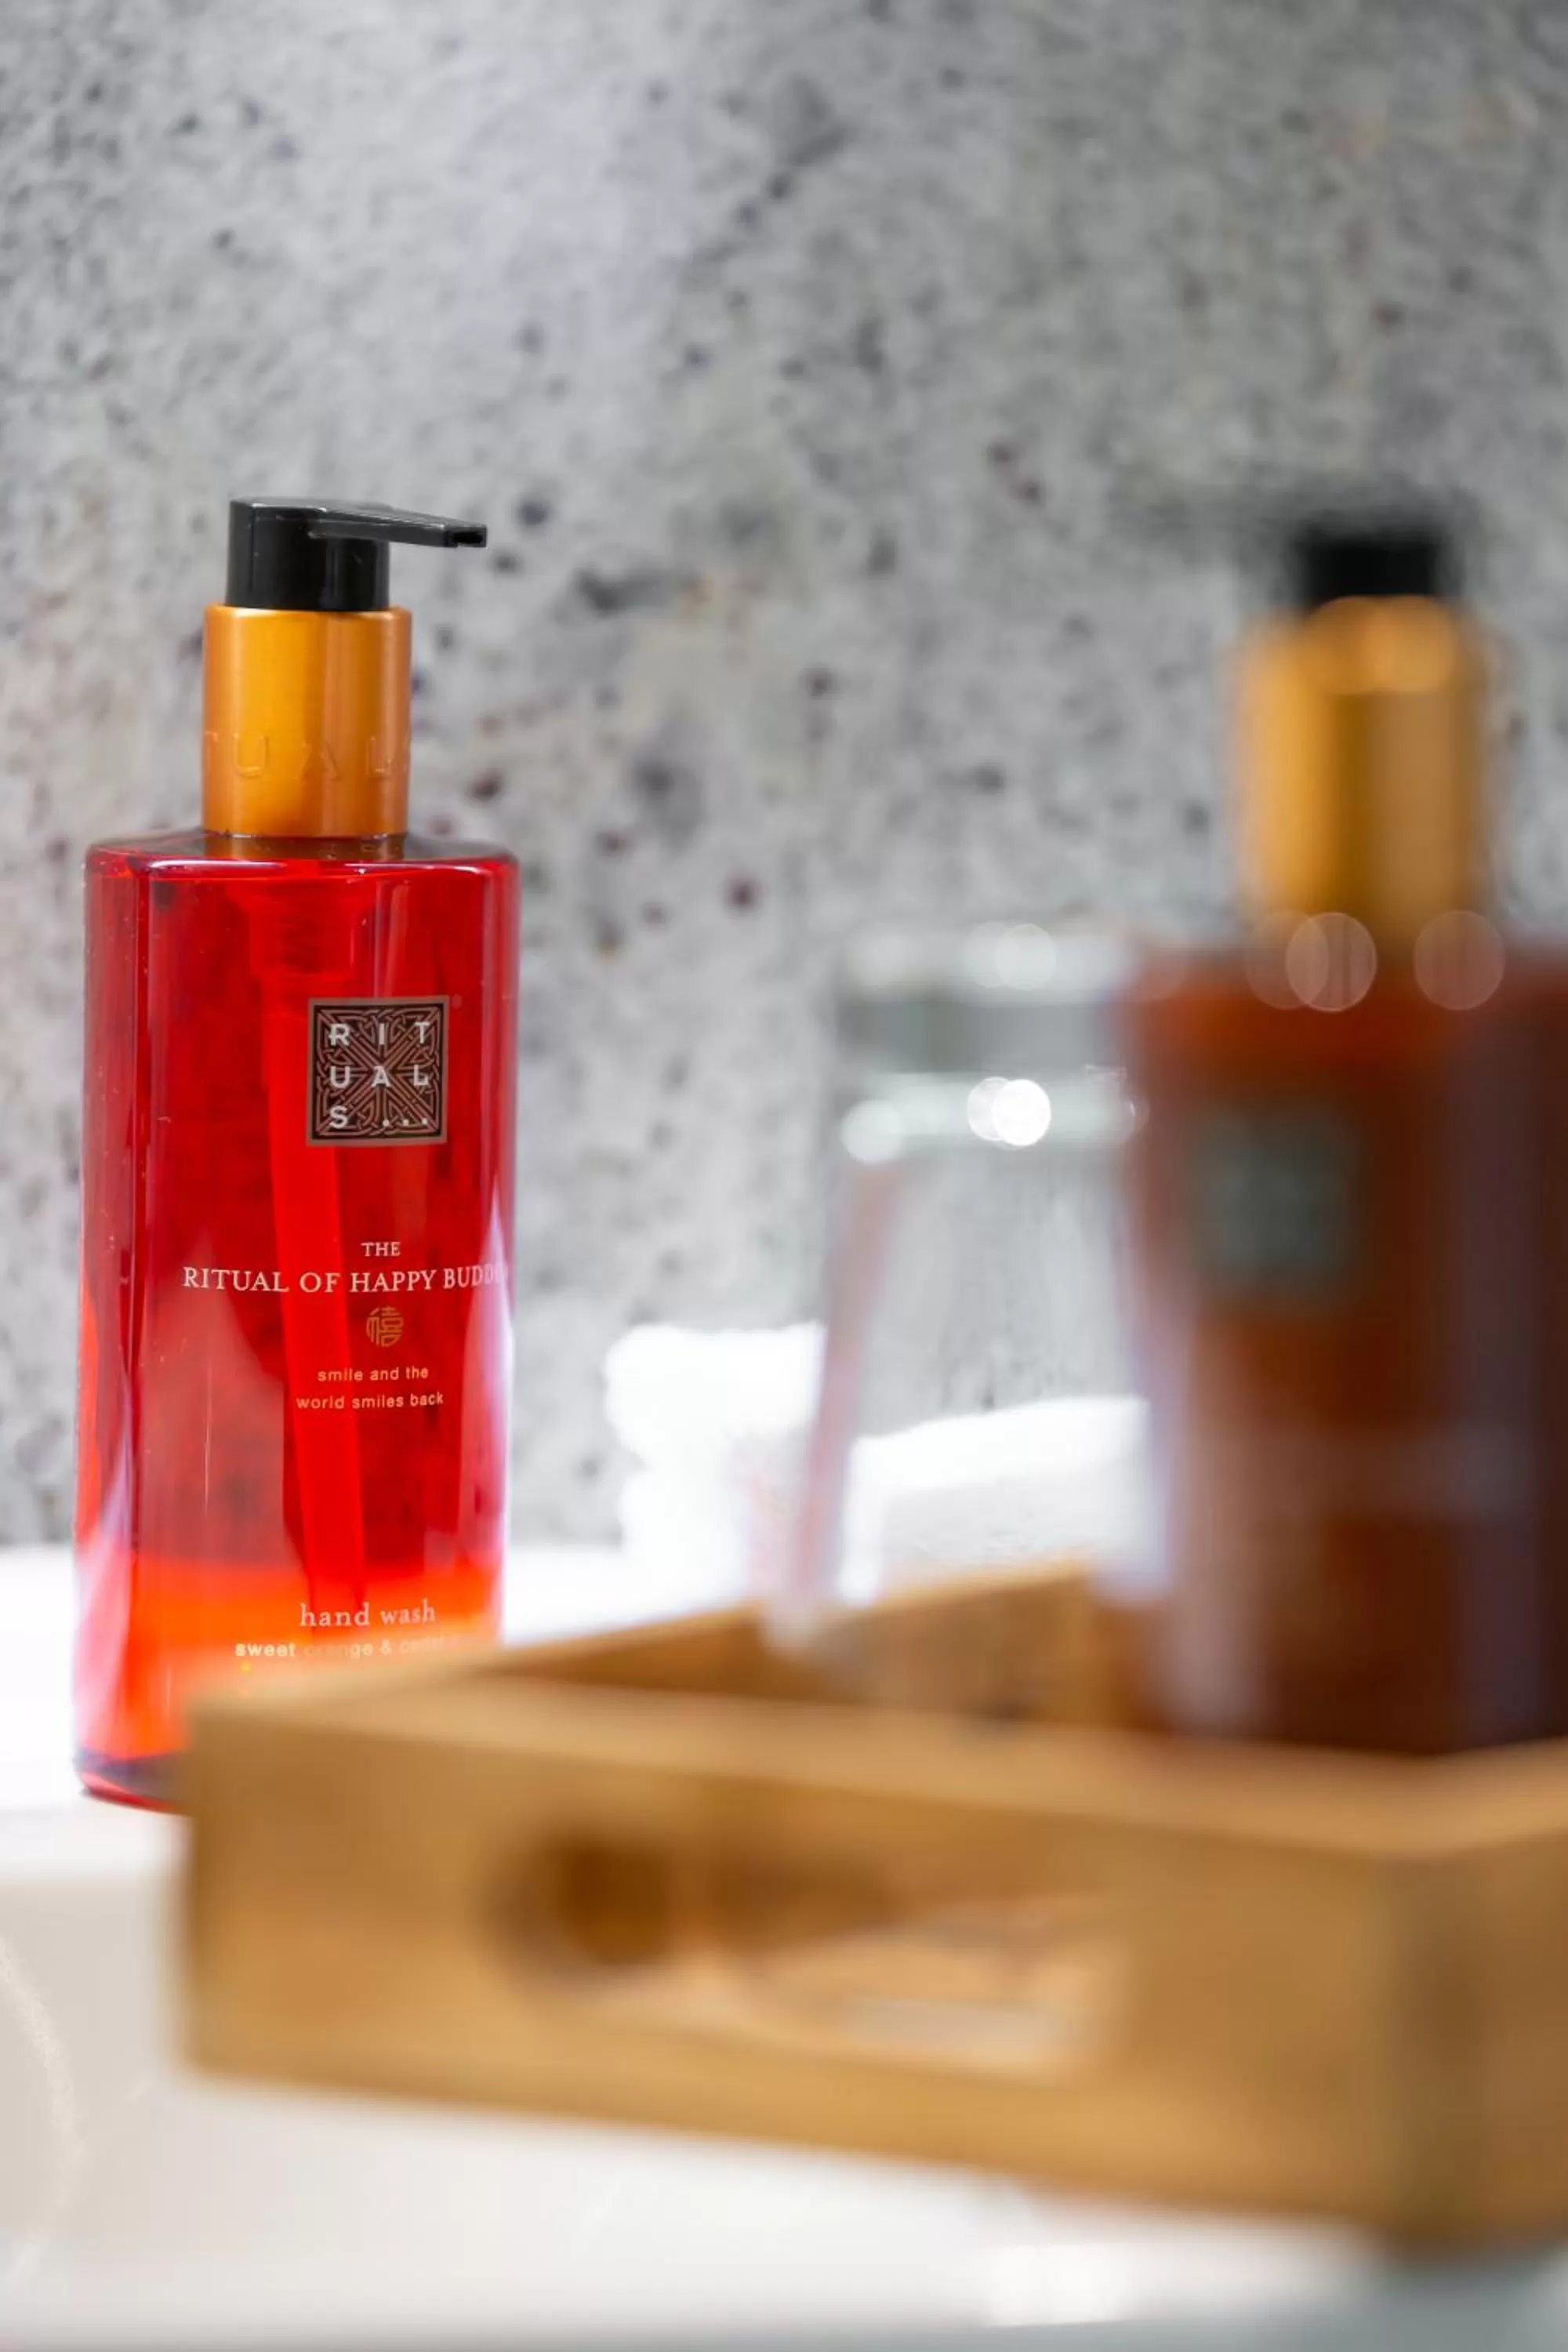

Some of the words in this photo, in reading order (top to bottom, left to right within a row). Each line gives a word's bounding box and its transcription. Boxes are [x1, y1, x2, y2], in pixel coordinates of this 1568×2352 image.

[361, 1241, 401, 1257] THE
[183, 1266, 289, 1293] RITUAL
[299, 1272, 340, 1294] OF
[350, 1269, 437, 1293] HAPPY
[318, 1367, 363, 1381] smile
[369, 1367, 399, 1381] and
[405, 1366, 428, 1380] the
[296, 1396, 345, 1410] world
[352, 1394, 404, 1409] smiles
[410, 1392, 444, 1406] back
[299, 1602, 371, 1627] hand
[379, 1598, 436, 1624] wash
[235, 1642, 296, 1657] sweet
